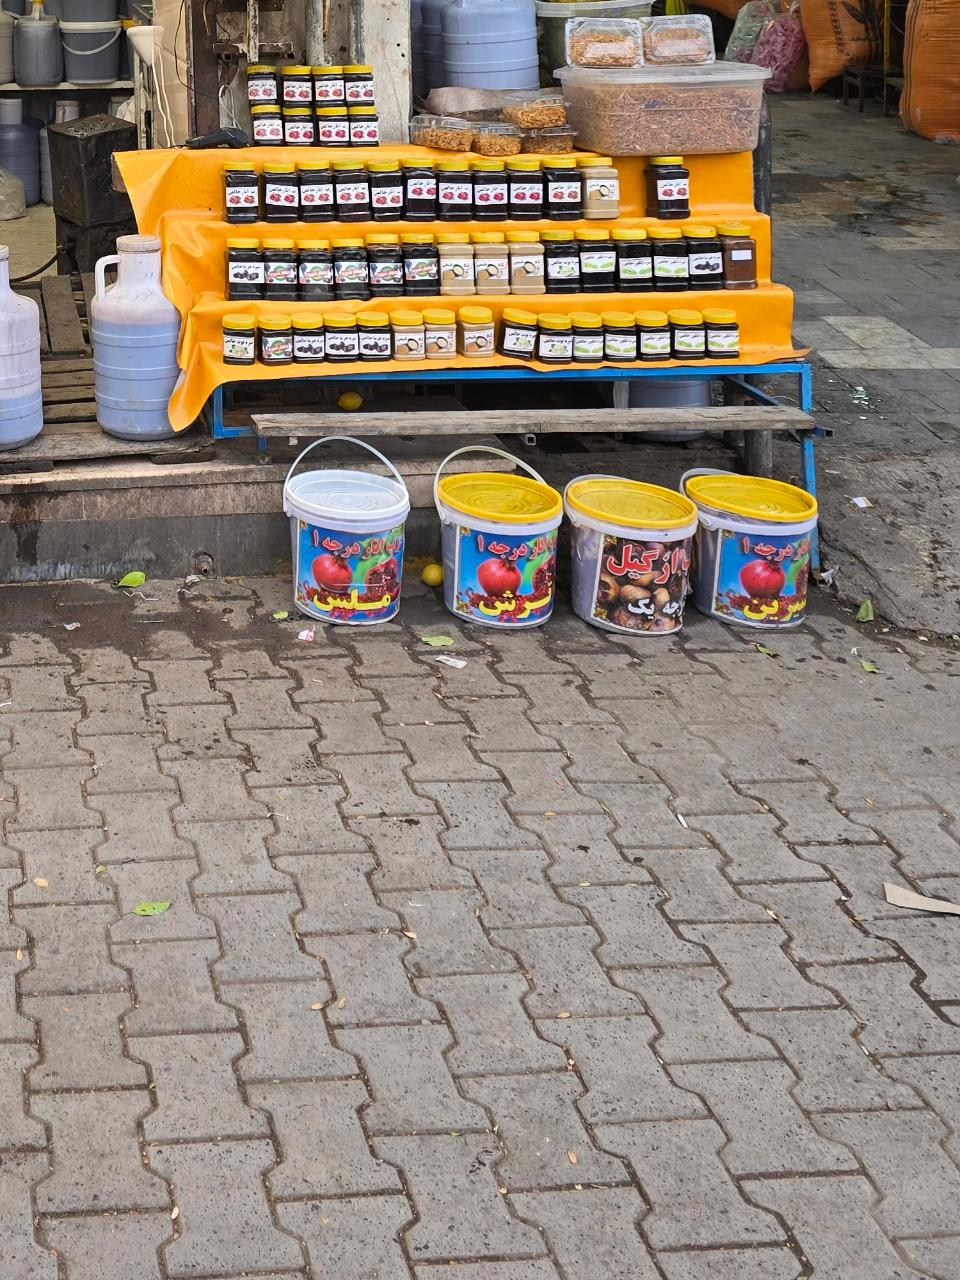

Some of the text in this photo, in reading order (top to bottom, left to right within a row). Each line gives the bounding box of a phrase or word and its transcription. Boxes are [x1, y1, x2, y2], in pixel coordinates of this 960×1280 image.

[321, 537, 361, 559] درجه
[488, 541, 528, 561] درجه
[754, 542, 794, 562] درجه
[606, 544, 680, 585] ازگیل
[313, 589, 392, 612] ملس
[478, 580, 553, 619] ترش
[627, 598, 655, 620] یک
